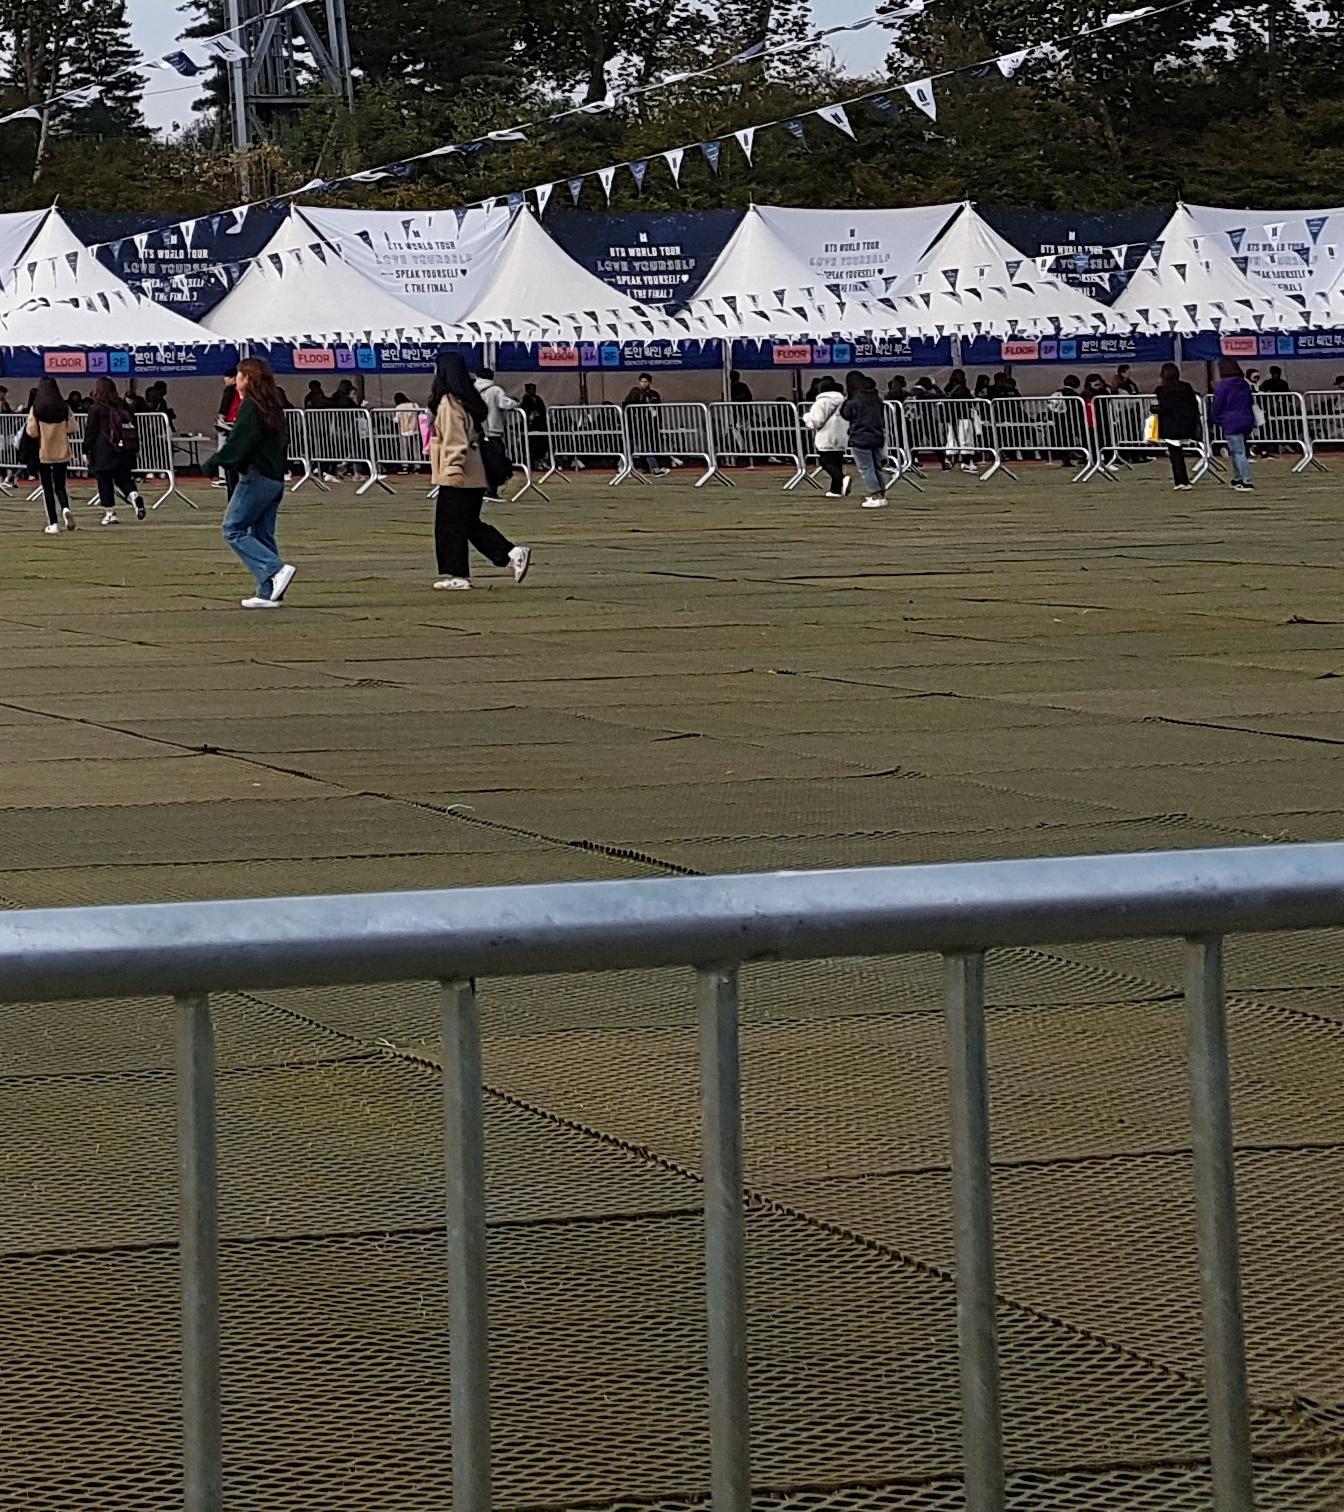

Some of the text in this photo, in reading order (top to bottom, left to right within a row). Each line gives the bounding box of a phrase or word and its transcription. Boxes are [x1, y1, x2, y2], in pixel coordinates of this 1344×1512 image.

[628, 247, 657, 257] WORLD
[659, 246, 681, 256] TOUR
[395, 269, 459, 278] SPEAK YOURSELF
[643, 275, 680, 285] YOURSELF
[298, 354, 330, 363] FLOOR
[777, 350, 807, 359] FLOOR
[49, 358, 81, 367] FLOOR
